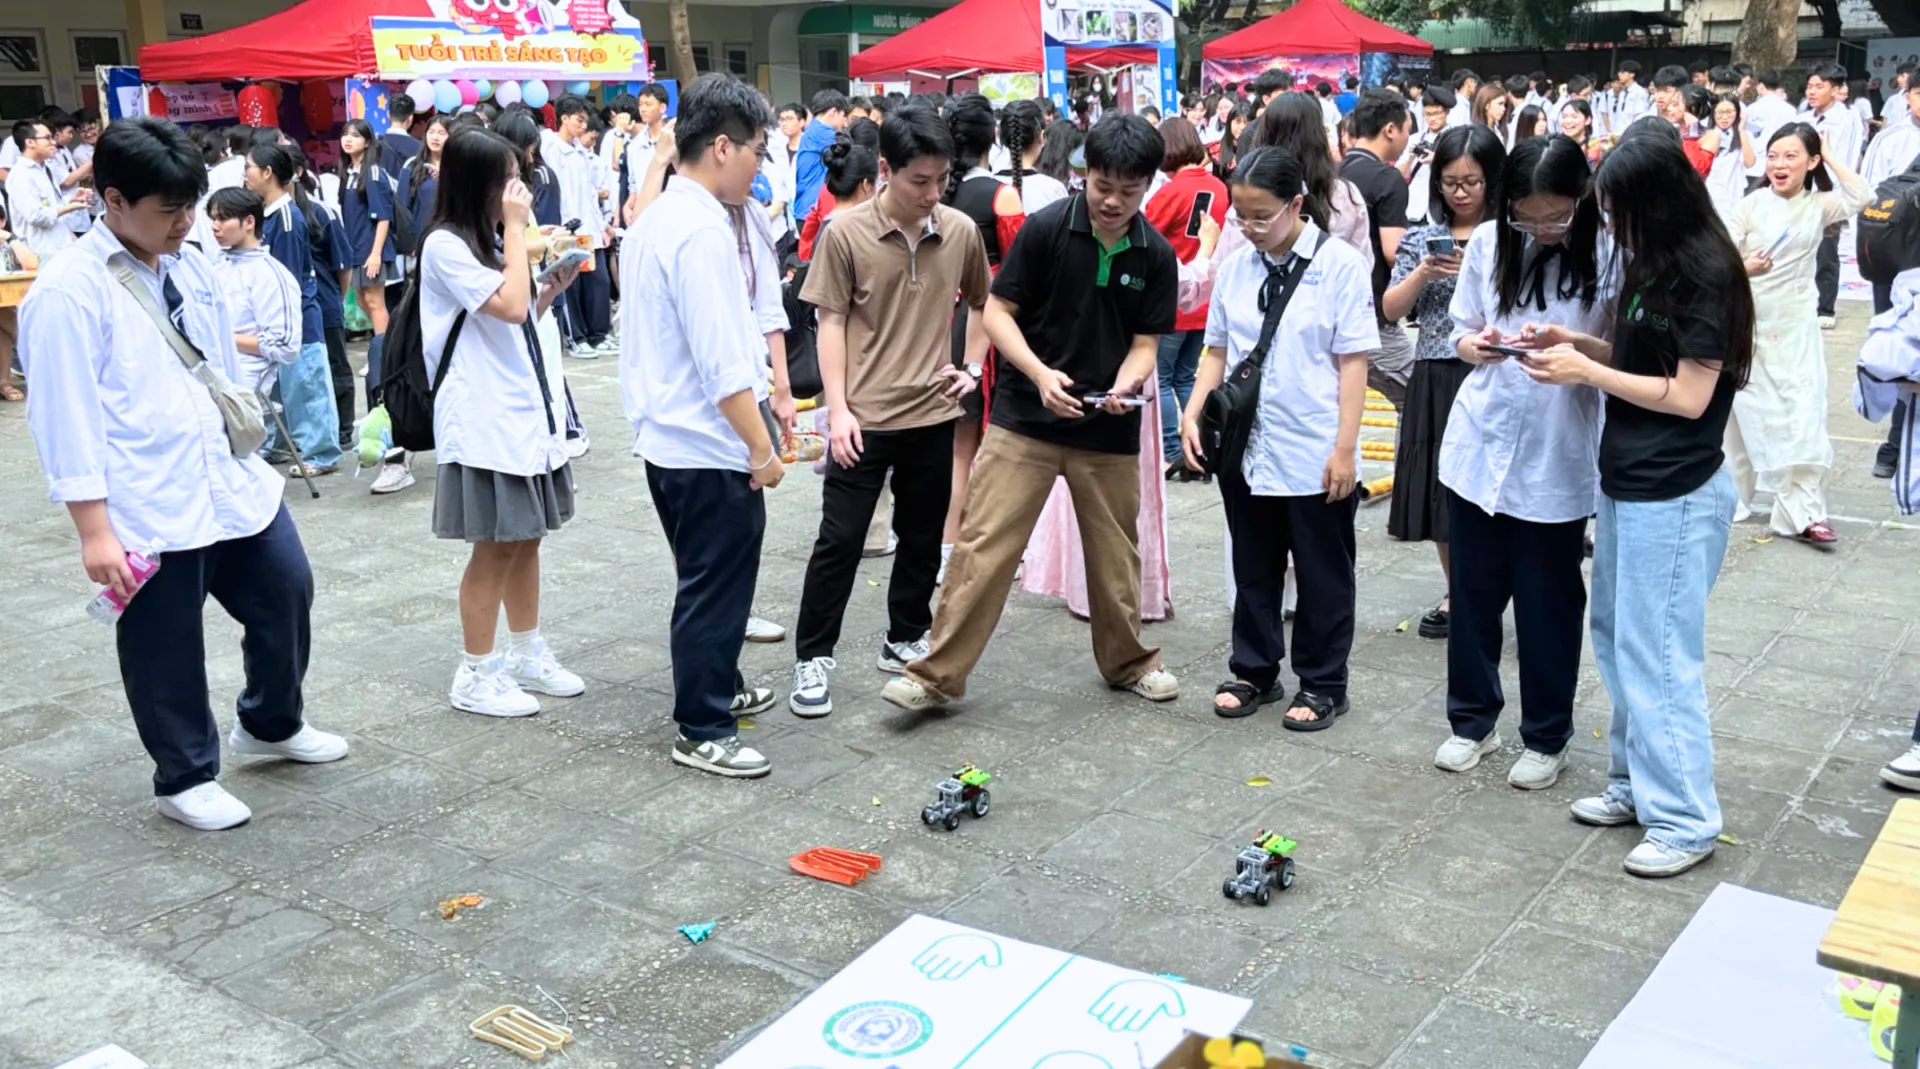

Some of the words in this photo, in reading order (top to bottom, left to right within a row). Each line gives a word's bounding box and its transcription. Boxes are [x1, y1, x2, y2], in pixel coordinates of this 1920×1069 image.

[396, 34, 457, 60] TUỔI
[459, 40, 502, 61] TRẺ
[505, 40, 563, 62] SÁNG
[565, 47, 608, 67] TẠO
